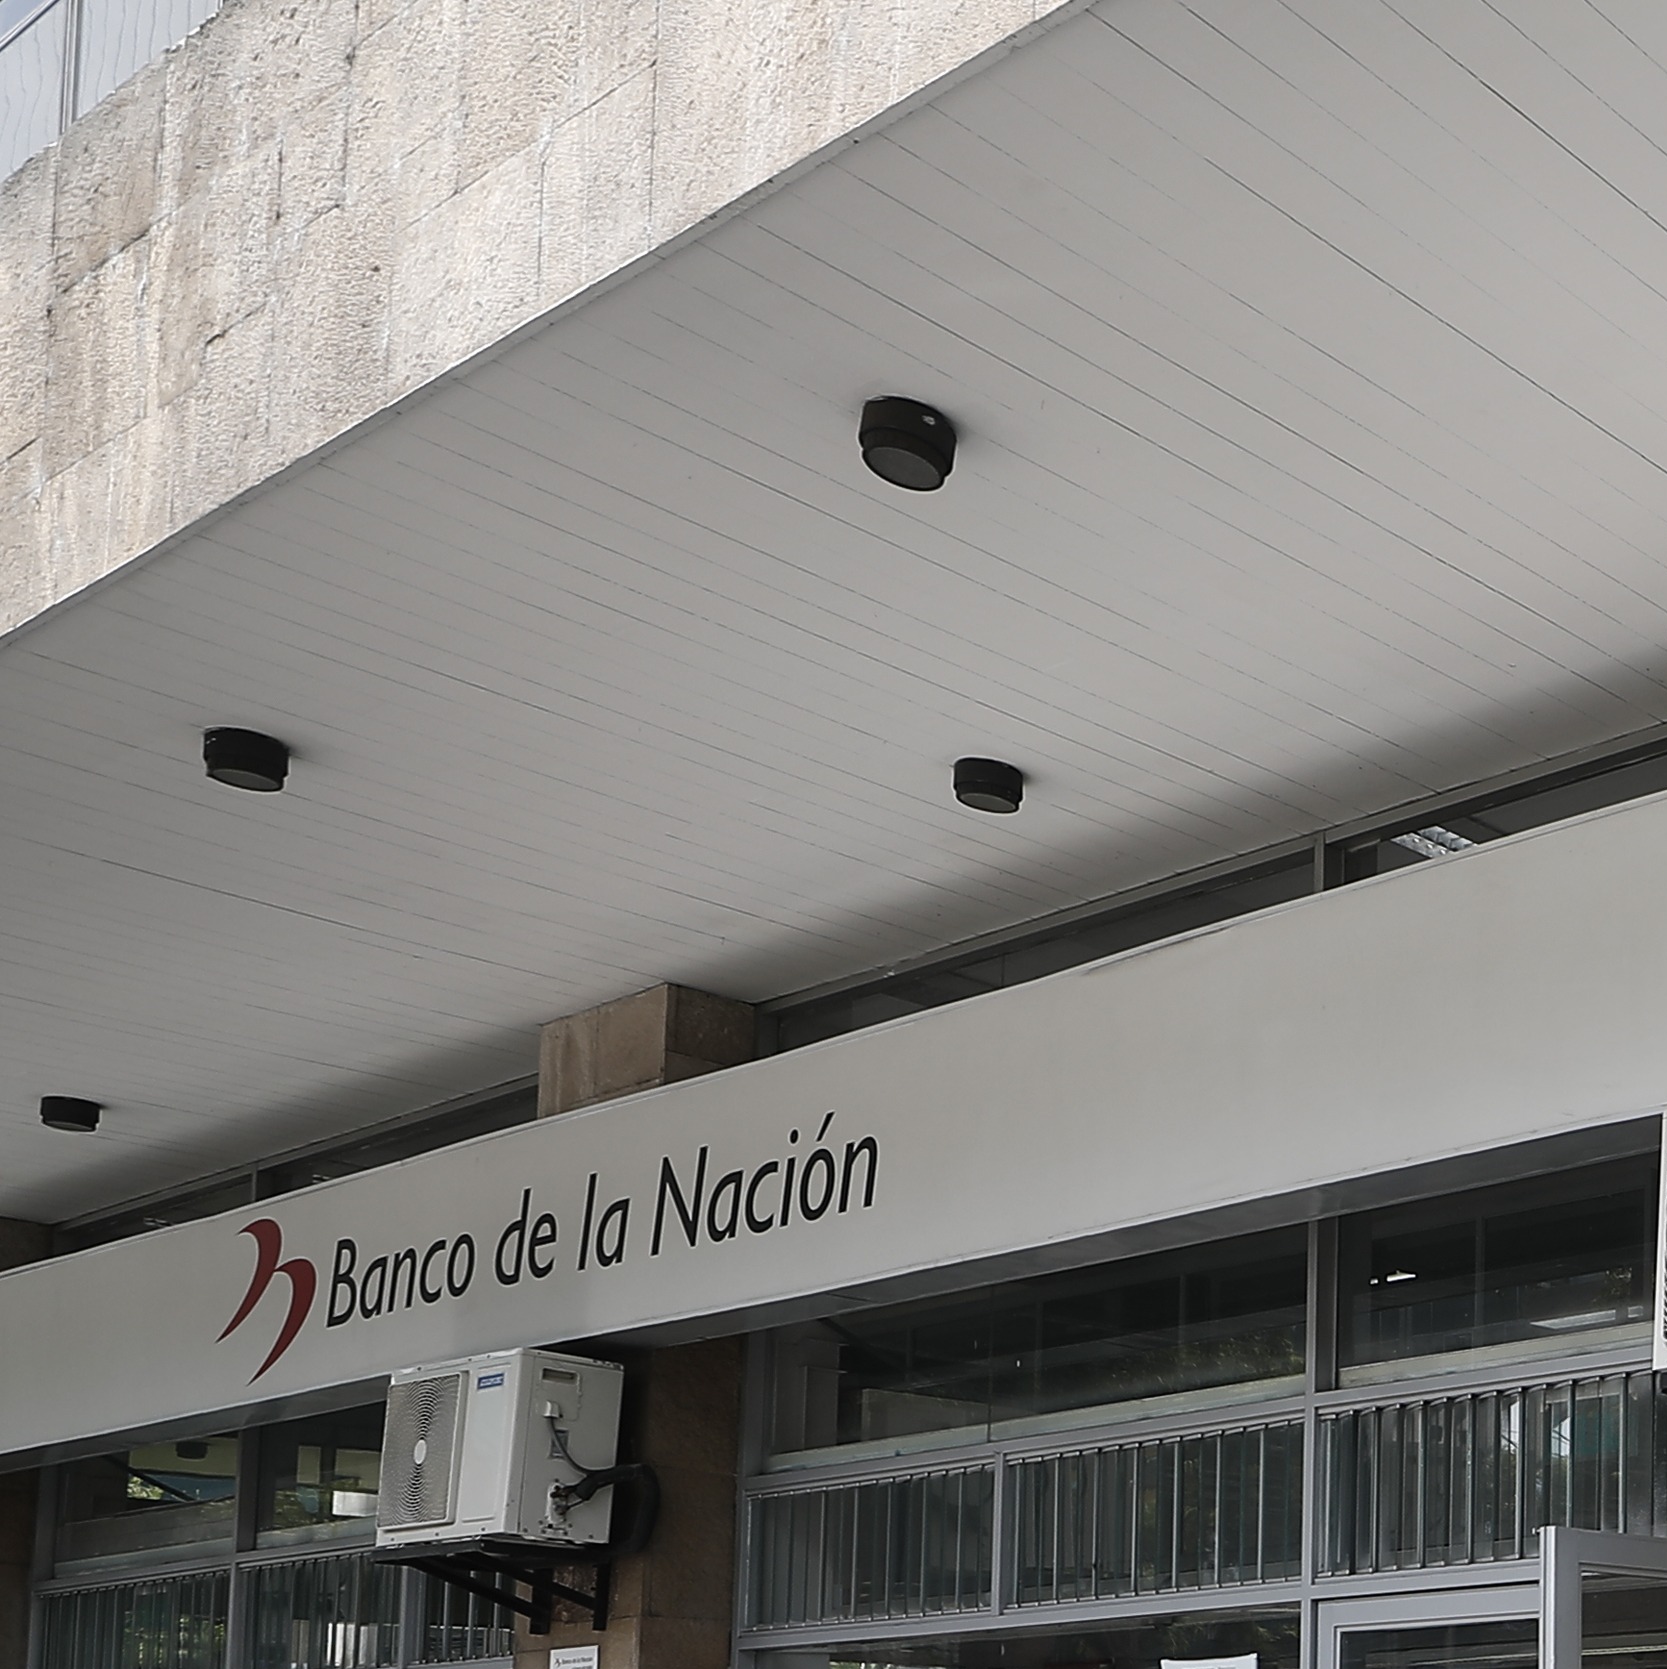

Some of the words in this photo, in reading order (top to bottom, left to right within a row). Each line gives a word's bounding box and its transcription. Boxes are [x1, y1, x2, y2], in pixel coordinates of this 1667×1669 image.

[327, 1234, 474, 1327] Banco
[495, 1191, 556, 1285] de
[578, 1175, 630, 1270] la
[651, 1113, 877, 1256] Nación
